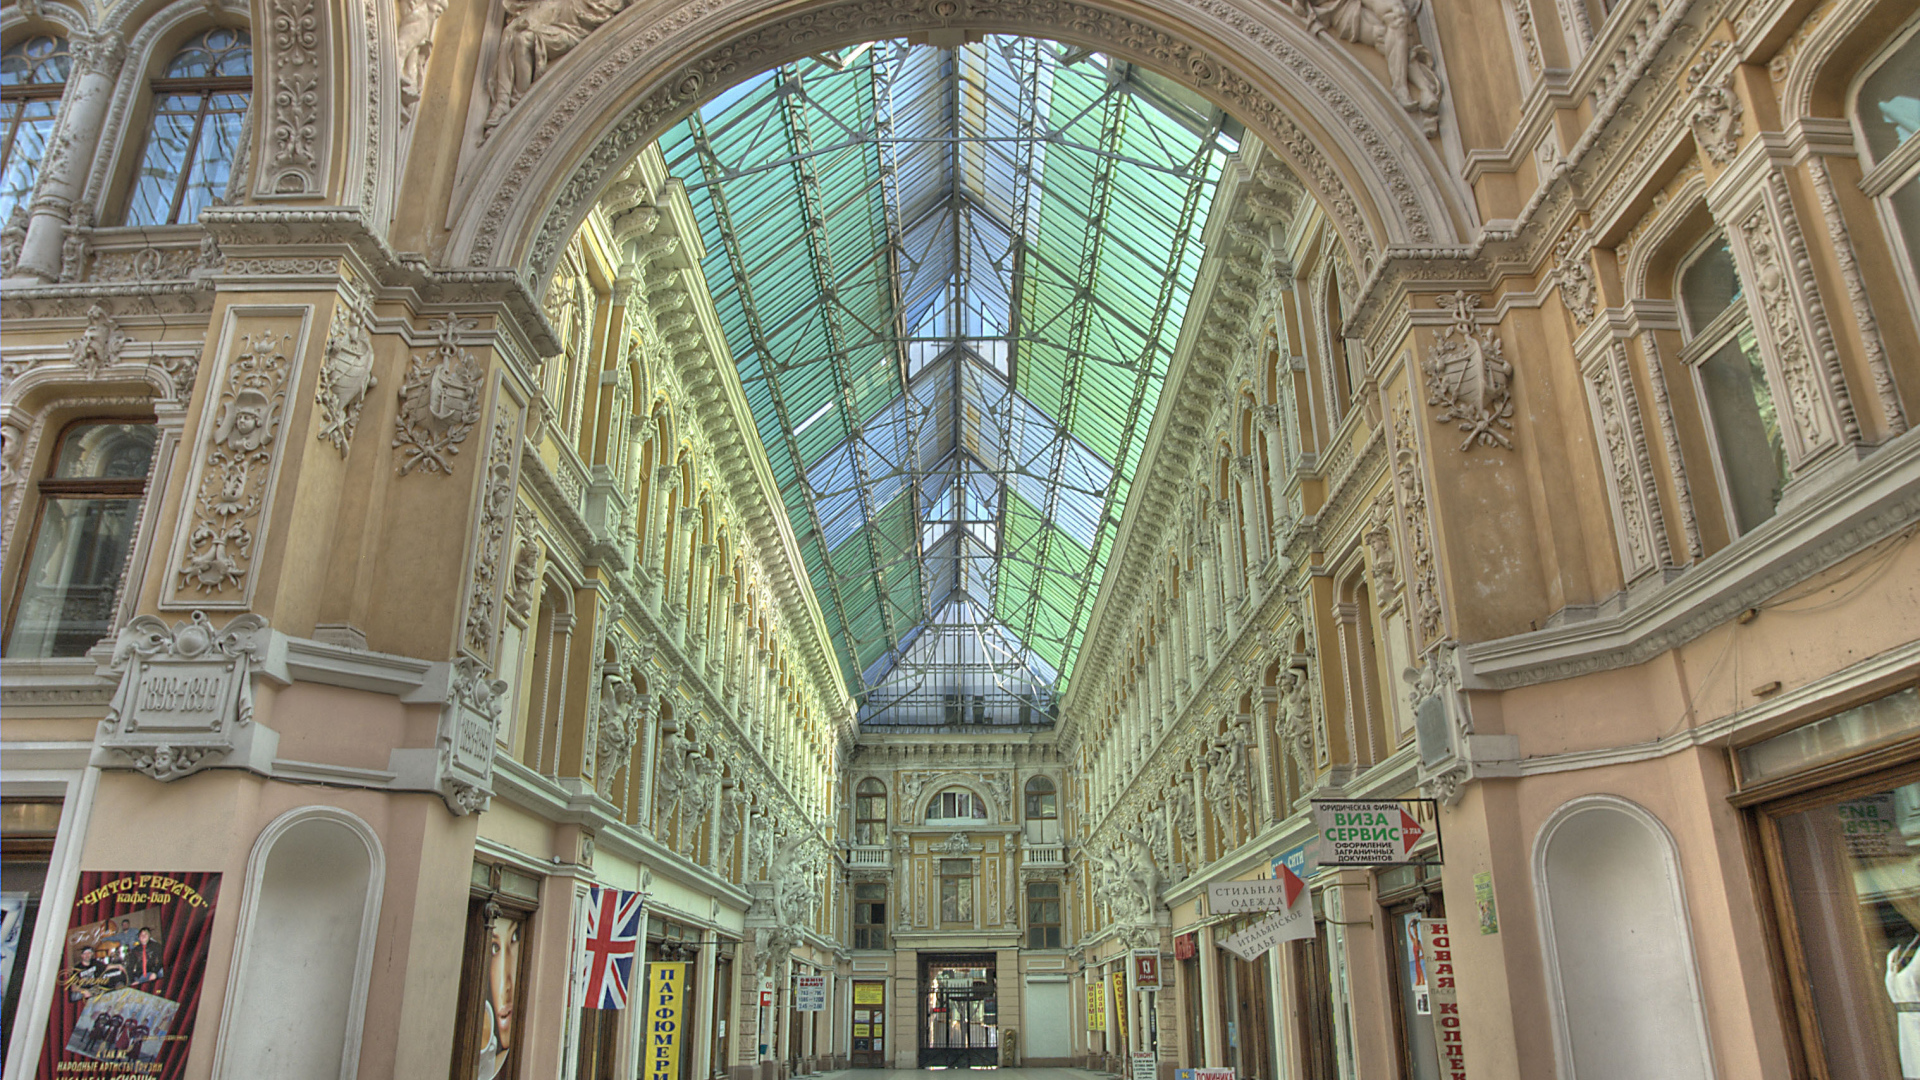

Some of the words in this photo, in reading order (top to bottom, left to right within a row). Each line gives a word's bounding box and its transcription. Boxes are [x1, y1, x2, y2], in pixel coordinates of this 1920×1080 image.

[1335, 813, 1389, 826] ВИЗА
[1325, 828, 1400, 841] СЕРВИС
[1215, 885, 1282, 896] СТИЛЬНАЯ
[1231, 898, 1283, 908] ОДЕЖДА
[1237, 910, 1303, 947] ИТАЛЬЯНСКОЕ
[1242, 936, 1277, 958] БЕЛЬЕ
[1431, 923, 1455, 988] НОВАЯ
[57, 1061, 98, 1072] НАРОДНЫЕ
[99, 1061, 134, 1072] АРТИСТЫ
